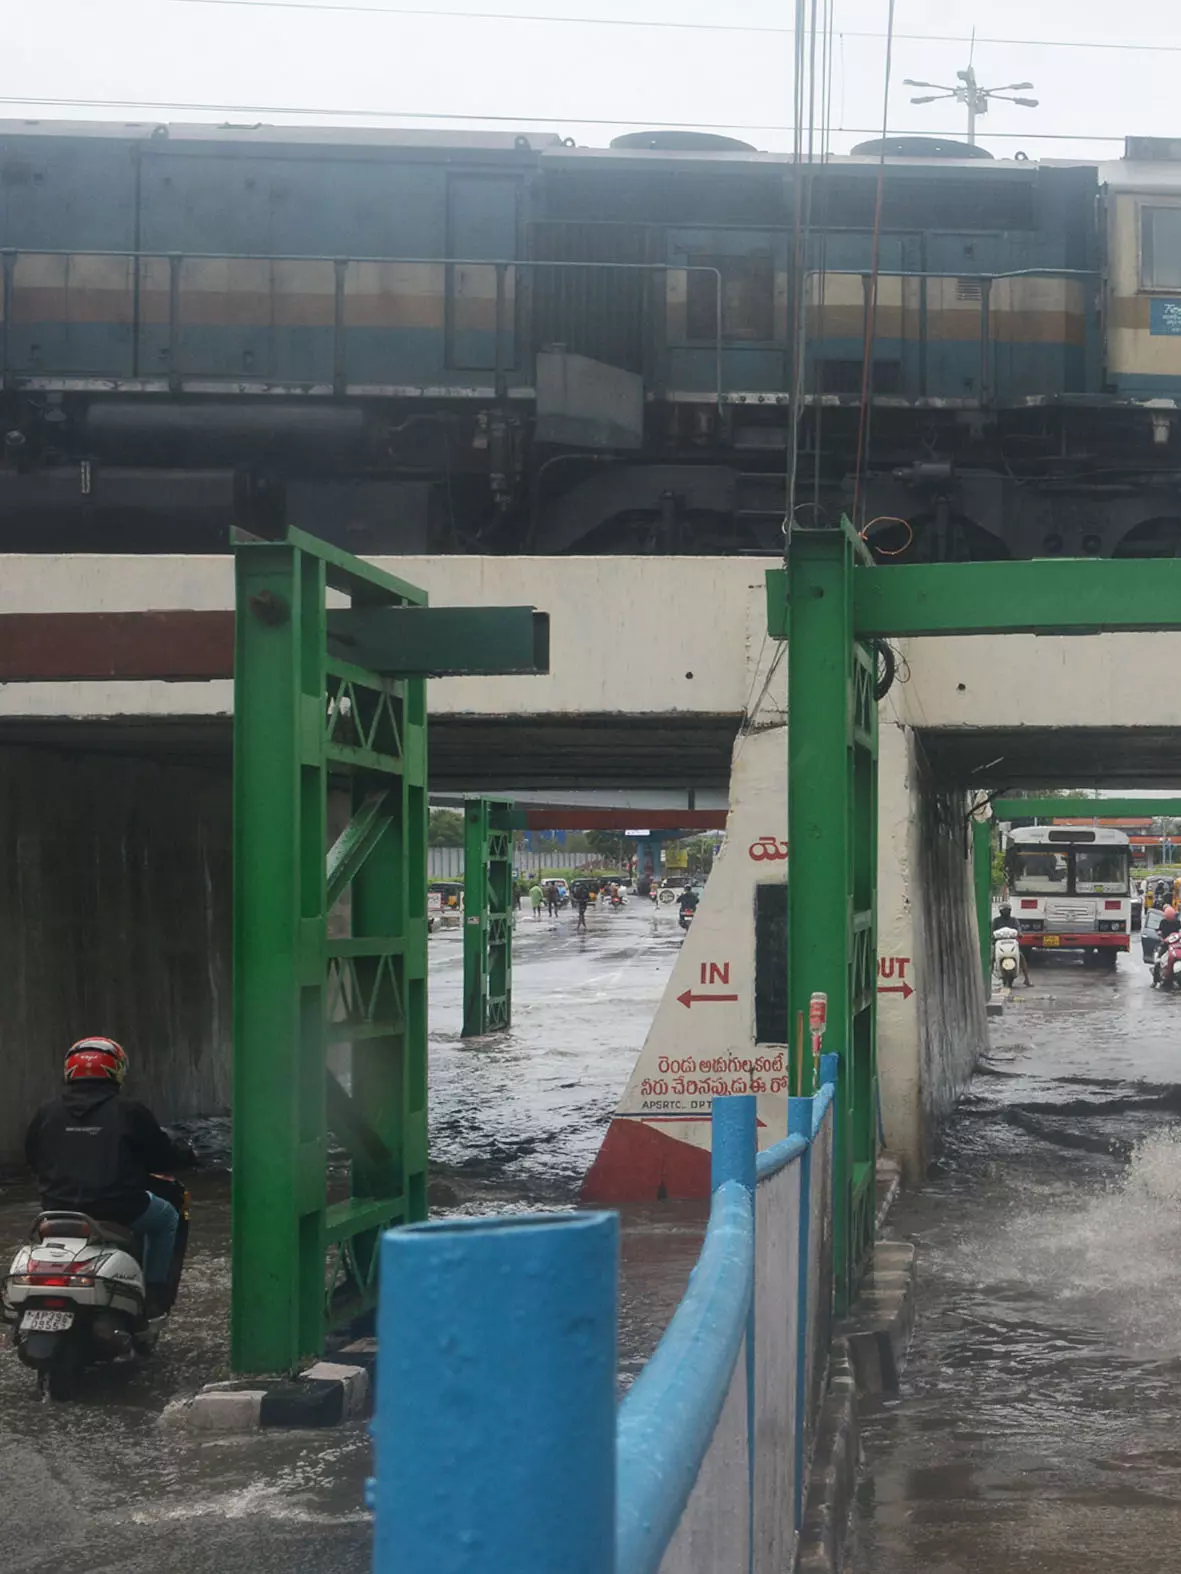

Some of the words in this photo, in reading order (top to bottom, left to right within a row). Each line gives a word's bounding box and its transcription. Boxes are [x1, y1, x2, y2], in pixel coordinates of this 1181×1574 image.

[700, 962, 730, 984] IN
[877, 956, 911, 979] UT
[658, 1056, 696, 1073] రెండు
[641, 1078, 668, 1096] నీరు
